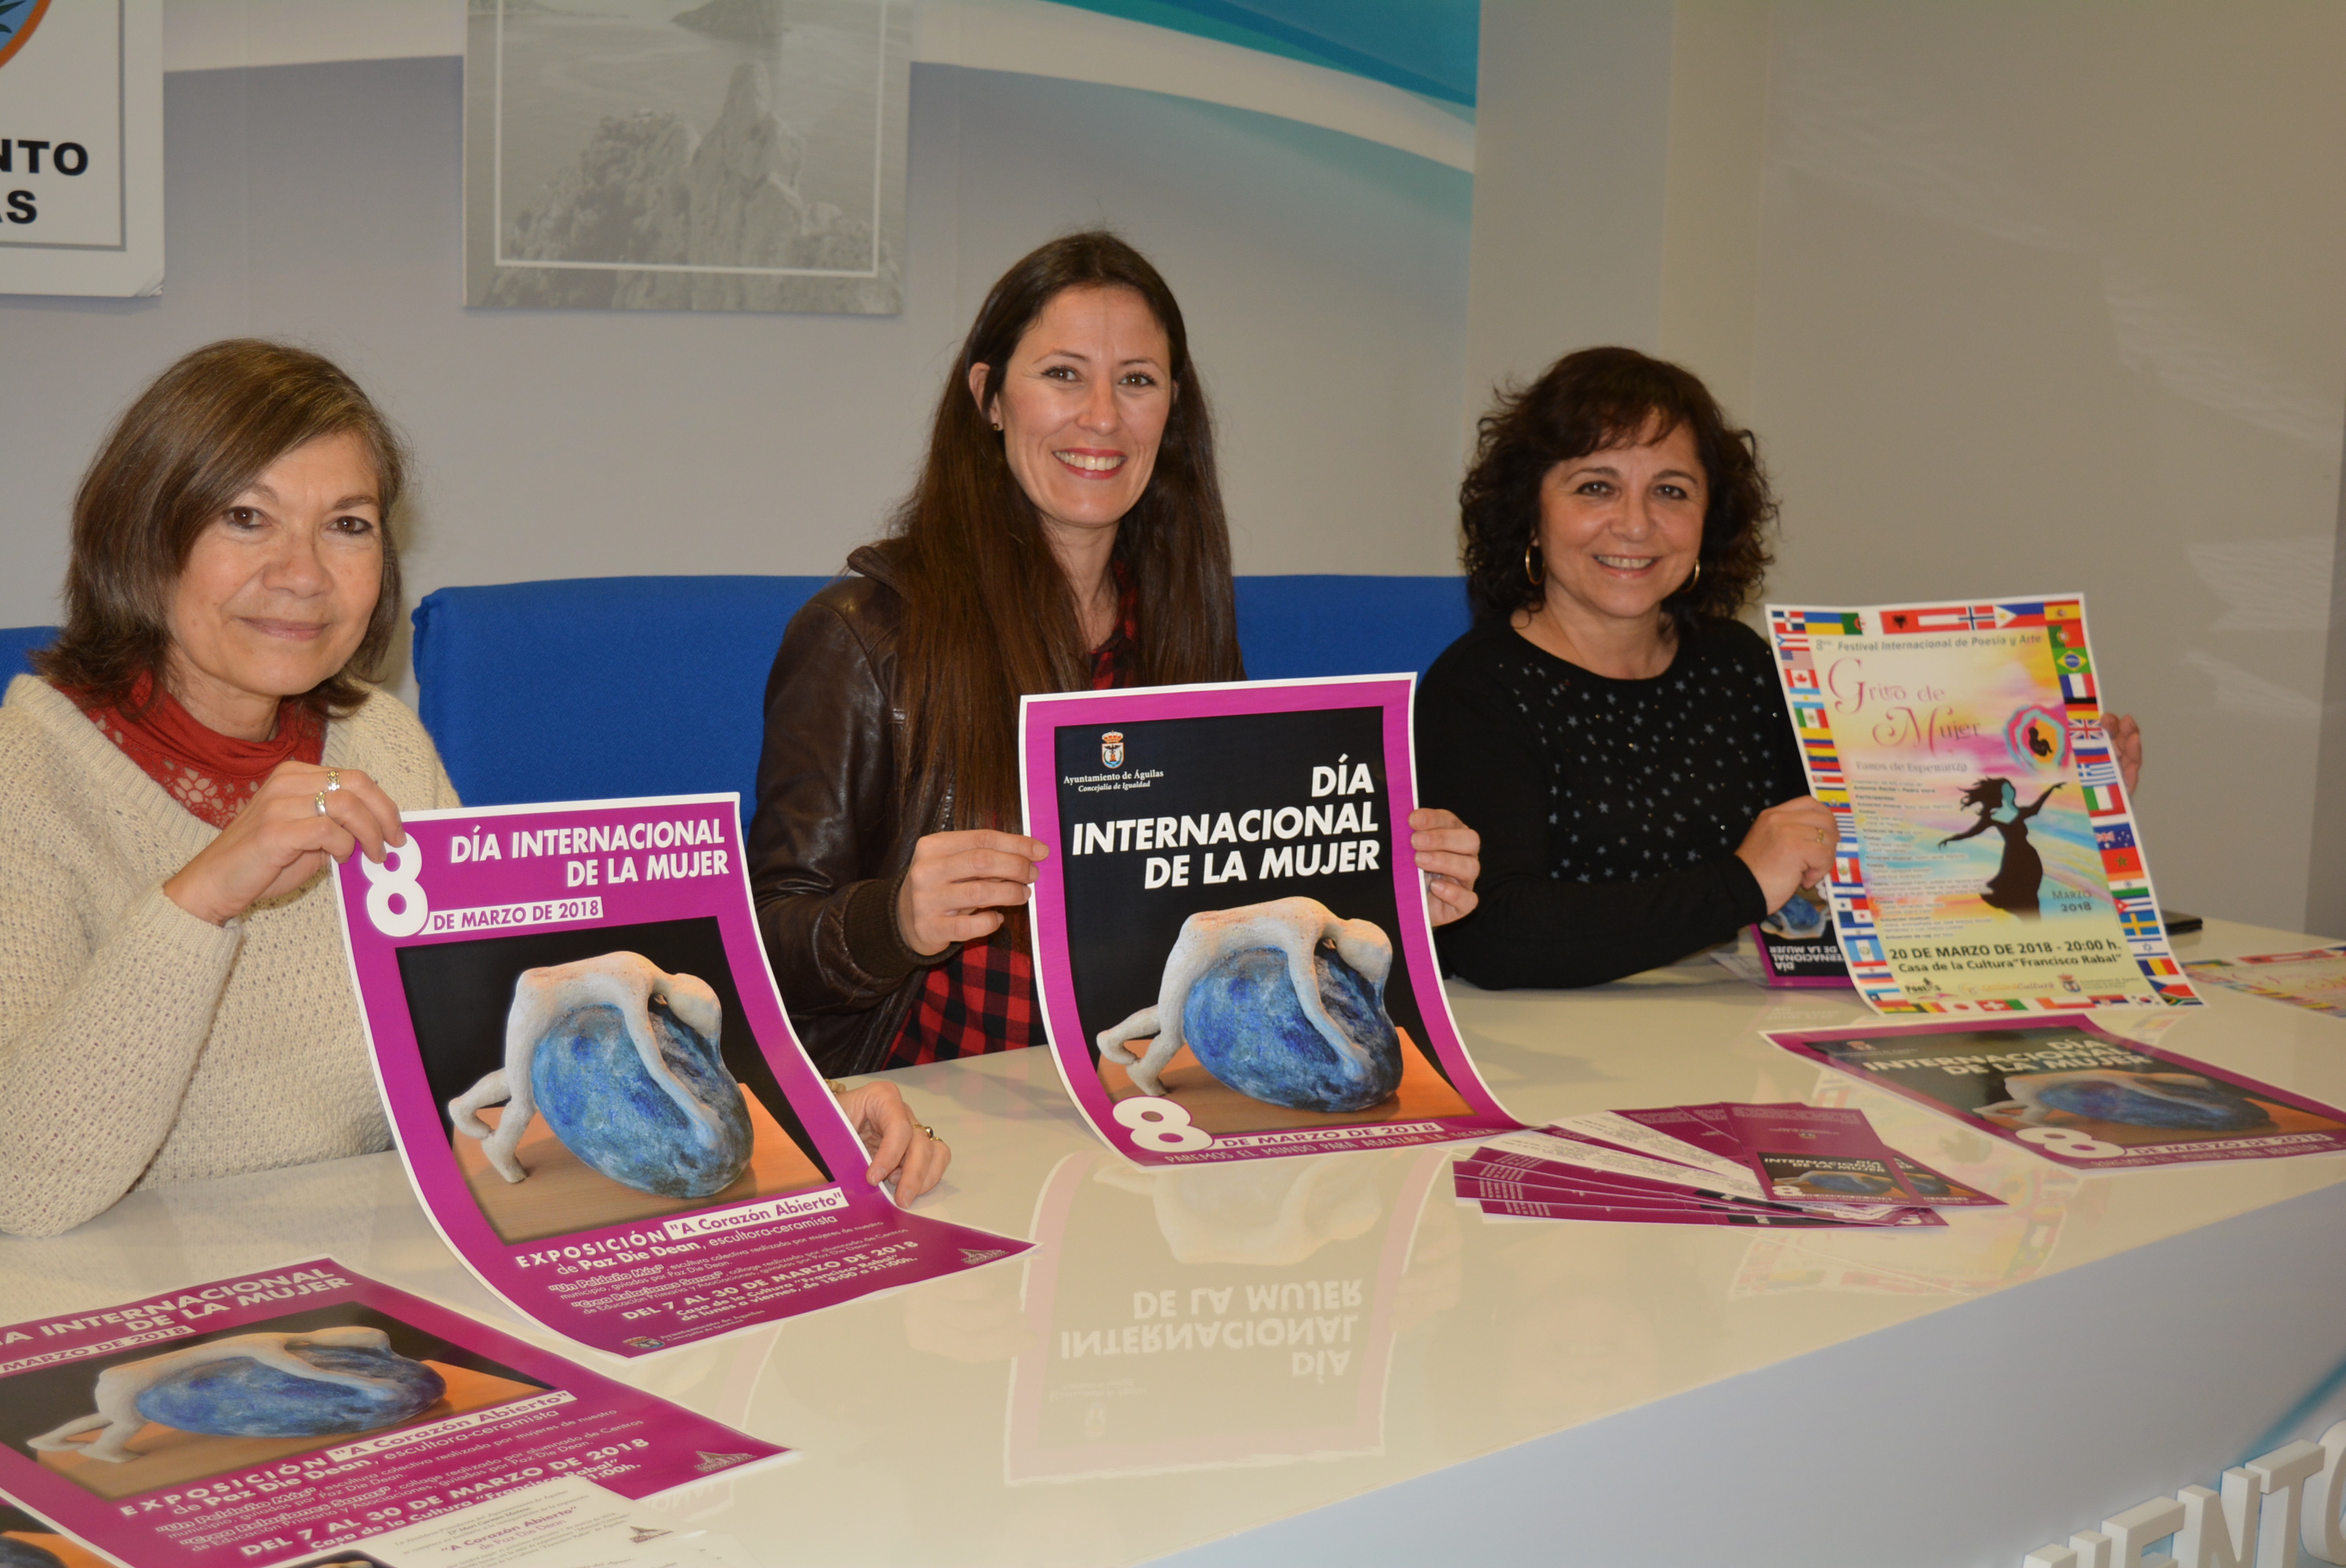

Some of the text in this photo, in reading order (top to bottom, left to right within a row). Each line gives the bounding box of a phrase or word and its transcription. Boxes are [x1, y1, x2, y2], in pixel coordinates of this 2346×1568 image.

[0, 190, 38, 224] S
[1838, 641, 1878, 651] Festival
[1882, 638, 1952, 650] Internacional
[1955, 637, 1968, 647] de
[1971, 635, 2006, 646] Poesía
[2010, 637, 2016, 646] y
[2020, 635, 2041, 644] Arte
[1828, 657, 1945, 714] Grito de
[1872, 706, 1981, 757] Mujer
[1063, 768, 1164, 786] Ayuntamiento de Águilas
[1078, 782, 1113, 793] Concejalía
[1123, 780, 1150, 791] Igualdad
[1311, 753, 1374, 797] DÍA
[1890, 761, 1904, 771] de
[450, 818, 724, 863] DÍA INTERNACIONAL
[1072, 801, 1378, 855] INTERNACIONAL
[361, 831, 428, 937] 8
[567, 850, 729, 887] DE LA MUJER
[1145, 840, 1380, 889] DE LA MUJER
[434, 900, 599, 931] DE MARZO DE 2018
[2061, 902, 2091, 911] 2018
[1769, 946, 1805, 954] MUJER
[1774, 961, 1795, 972] DÍA
[1890, 949, 1907, 960] 20
[1912, 948, 1931, 959] DE
[1936, 946, 1990, 957] MARZO
[1994, 944, 2014, 955] DE
[2018, 942, 2053, 953] 2018
[2065, 940, 2103, 952] 20:00
[2107, 938, 2122, 949] h.
[1898, 962, 1928, 973] Casa
[1932, 960, 1948, 971] de
[1952, 960, 1963, 970] la
[1862, 1047, 2132, 1071] INTERNACIONAL
[1942, 1054, 2154, 1076] DE LA MUJER
[2046, 1039, 2109, 1051] DÍA
[1113, 1096, 1436, 1152] 8 DE MARZO DE 2018
[2015, 1127, 2126, 1158] 8
[2165, 1142, 2240, 1152] MARZO
[2246, 1138, 2268, 1147] DE
[2279, 1134, 2328, 1144] 2018
[1164, 1151, 1233, 1163] PAREMOS
[1261, 1144, 1317, 1156] MUNDO
[1320, 1141, 1359, 1150] PARA
[516, 1192, 841, 1268] EXPOSICIÓN "A Corazón Abierto"
[557, 1263, 579, 1275] de
[578, 1257, 618, 1270] Paz
[616, 1250, 650, 1263] Die
[709, 1215, 838, 1247] escultora-ceramista
[39, 1268, 335, 1336] INTERNACIONAL
[621, 1240, 919, 1320] DEL 7 AL 30 DE MARZO DE 2018
[676, 1304, 710, 1316] Casa
[746, 1282, 794, 1298] Cultura
[681, 1313, 699, 1322] de
[699, 1303, 737, 1316] lunes
[750, 1287, 801, 1304] viernes,
[820, 1272, 857, 1285] 18:00
[871, 1256, 918, 1271] 21:00h.
[124, 1277, 354, 1331] DE LA MUJER
[2, 1326, 188, 1371] MARZO DE 2018
[120, 1392, 568, 1516] EXPOSICIÓN "A Corazón Abierto"
[172, 1501, 202, 1515] de
[202, 1490, 256, 1506] Paz
[256, 1477, 302, 1492] Die
[384, 1409, 560, 1460] escultora-ceramista
[325, 1473, 378, 1490] escultura
[381, 1457, 434, 1475] colectiva
[435, 1442, 492, 1461] realizada
[492, 1436, 514, 1447] por
[516, 1424, 559, 1440] mujeres
[578, 1410, 617, 1423] nuestro
[241, 1438, 649, 1555] DEL 7 AL 30 DE MARZO DE 2018
[310, 1500, 474, 1548] Casa de la Cultura
[463, 1525, 521, 1547] Corazón
[524, 1506, 577, 1527] Abierto"
